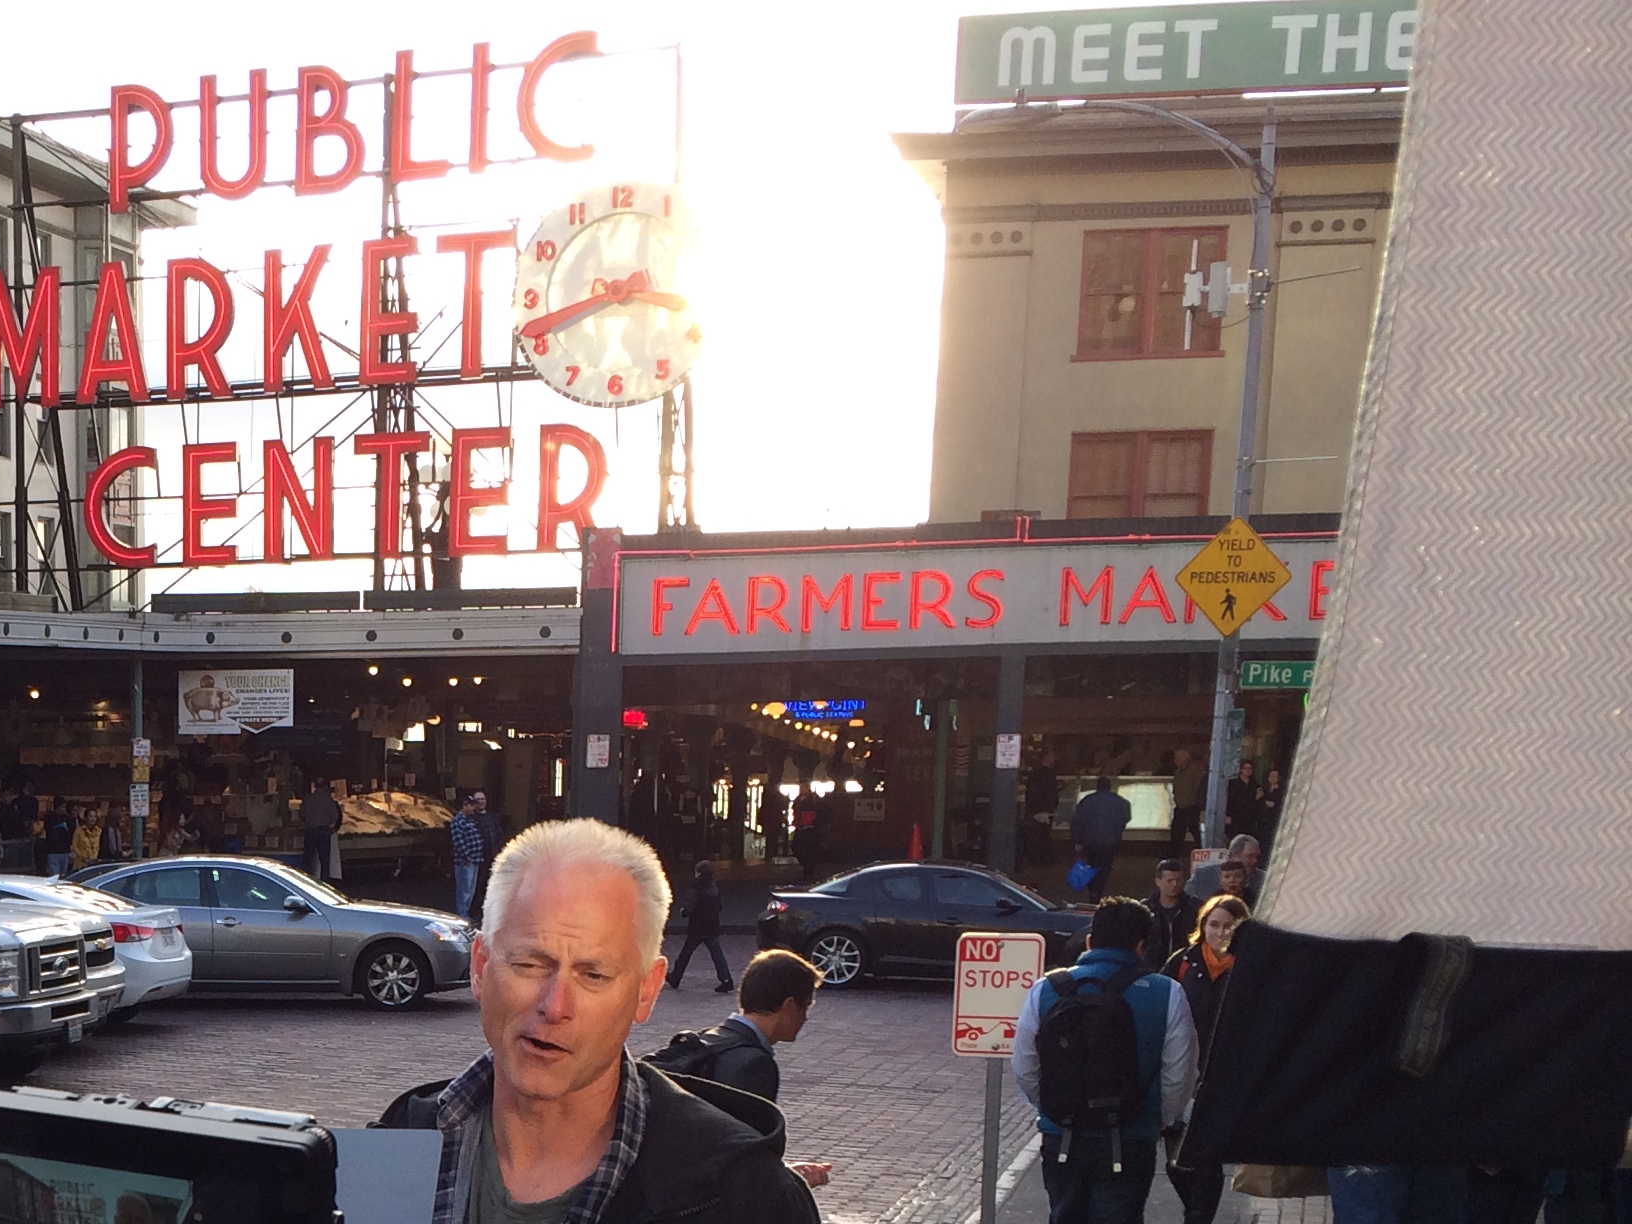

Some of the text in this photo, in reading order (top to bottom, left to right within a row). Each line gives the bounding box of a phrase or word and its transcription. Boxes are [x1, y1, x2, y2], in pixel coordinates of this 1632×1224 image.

[997, 9, 1418, 87] MEET THE
[110, 30, 598, 213] PUBLIC
[612, 185, 634, 209] 12
[569, 202, 585, 225] 11
[536, 240, 556, 262] 10
[524, 288, 539, 310] 9
[533, 333, 549, 356] 8
[565, 365, 580, 386] 7
[607, 374, 623, 396] 6
[84, 424, 608, 567] CENTER
[1218, 538, 1256, 551] YIELD
[1226, 555, 1242, 567] TO
[1189, 571, 1276, 584] PEDESTRIANS
[651, 568, 1005, 637] FARMERS
[1248, 663, 1292, 684] Pike
[965, 940, 998, 960] NO
[964, 969, 1035, 989] STOPS
